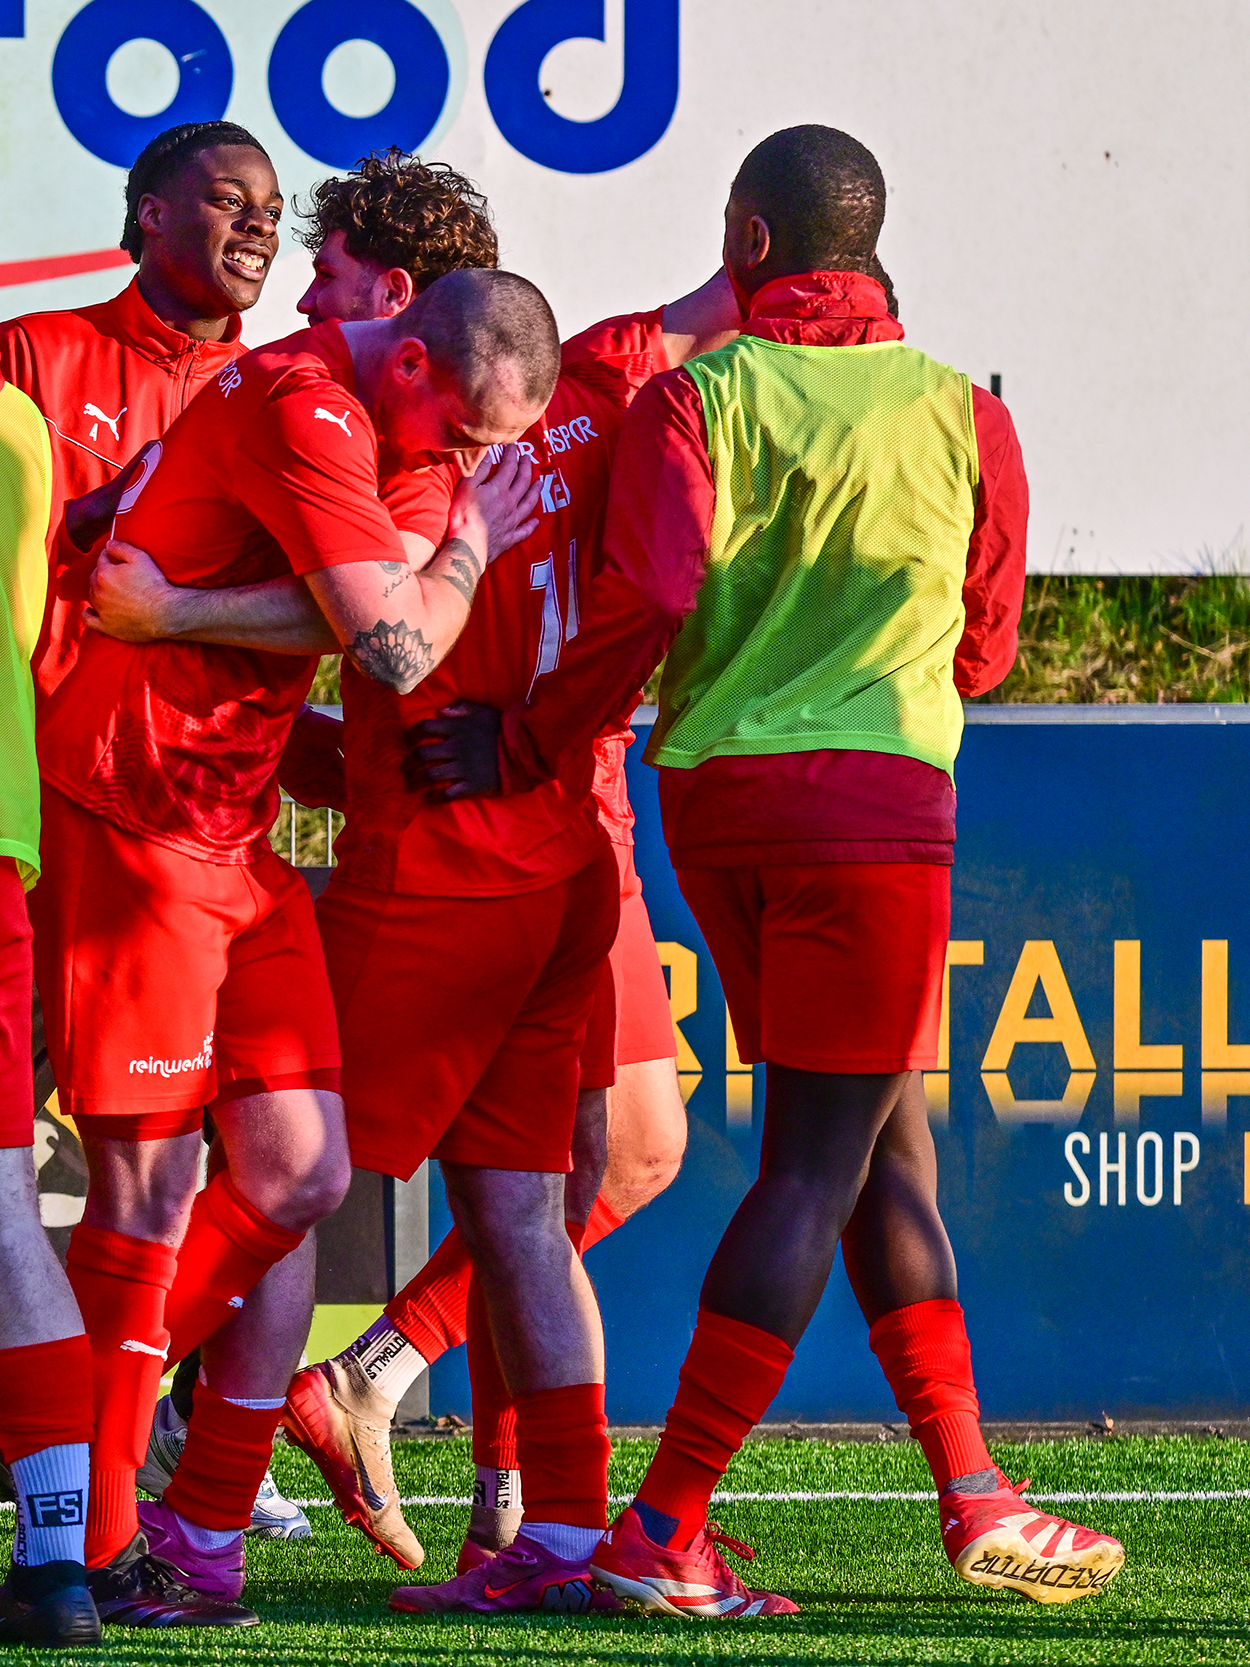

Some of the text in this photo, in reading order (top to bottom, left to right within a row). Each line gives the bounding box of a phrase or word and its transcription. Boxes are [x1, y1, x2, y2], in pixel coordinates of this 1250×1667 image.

[129, 1052, 205, 1078] reinwerk
[1064, 1131, 1200, 1206] SHOP
[33, 1493, 80, 1526] FS
[970, 1550, 1117, 1589] PREDATOR
